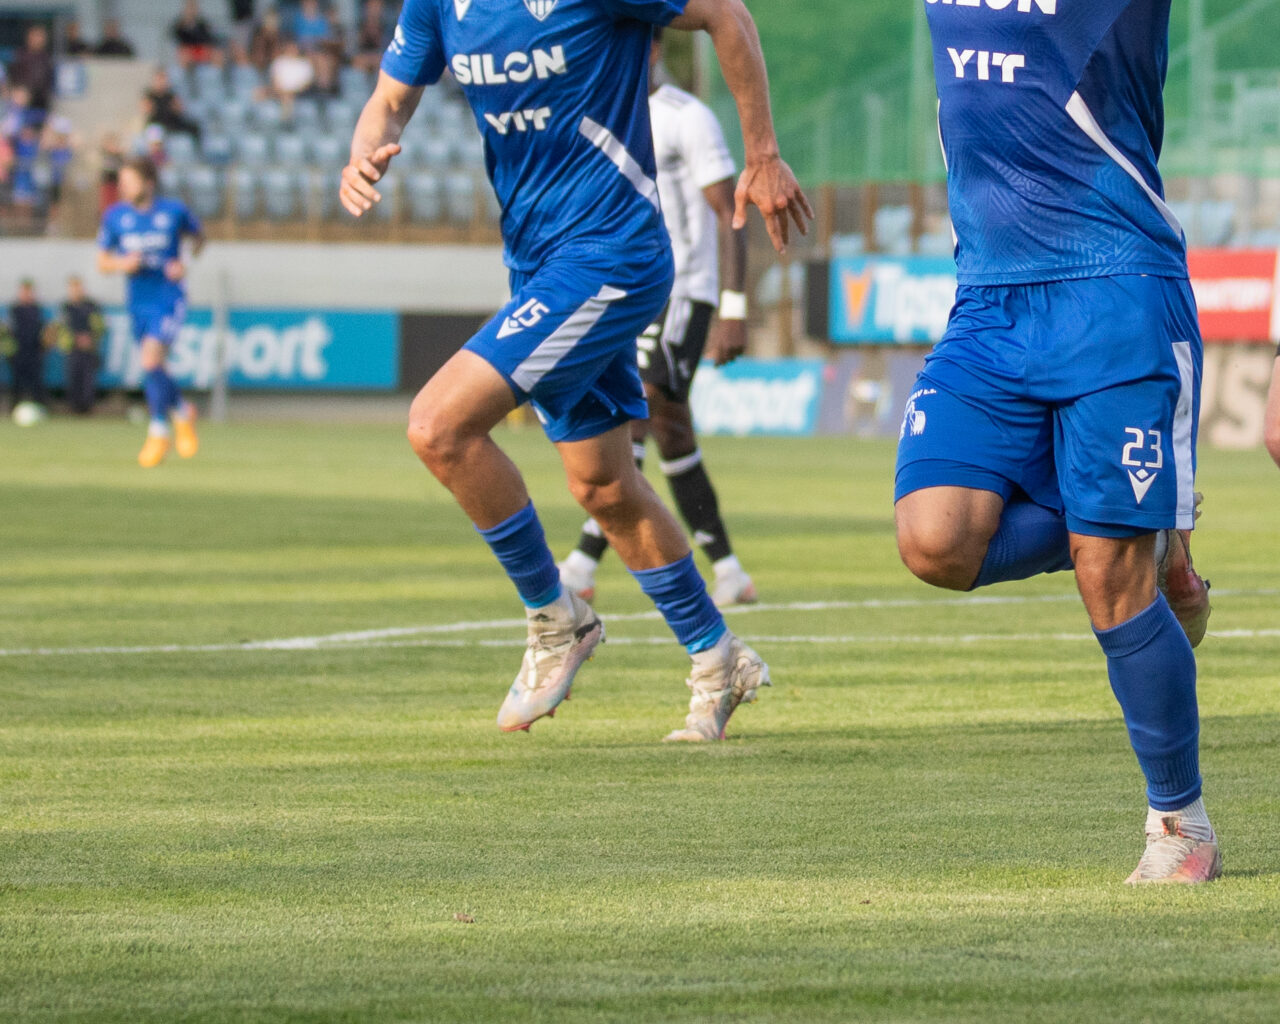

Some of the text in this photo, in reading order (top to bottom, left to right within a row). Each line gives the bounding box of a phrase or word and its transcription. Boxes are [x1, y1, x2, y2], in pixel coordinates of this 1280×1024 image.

[451, 45, 567, 85] SILON
[946, 47, 1025, 83] YIT
[485, 107, 551, 135] YIT
[512, 298, 549, 326] 15
[1122, 426, 1163, 468] 23
